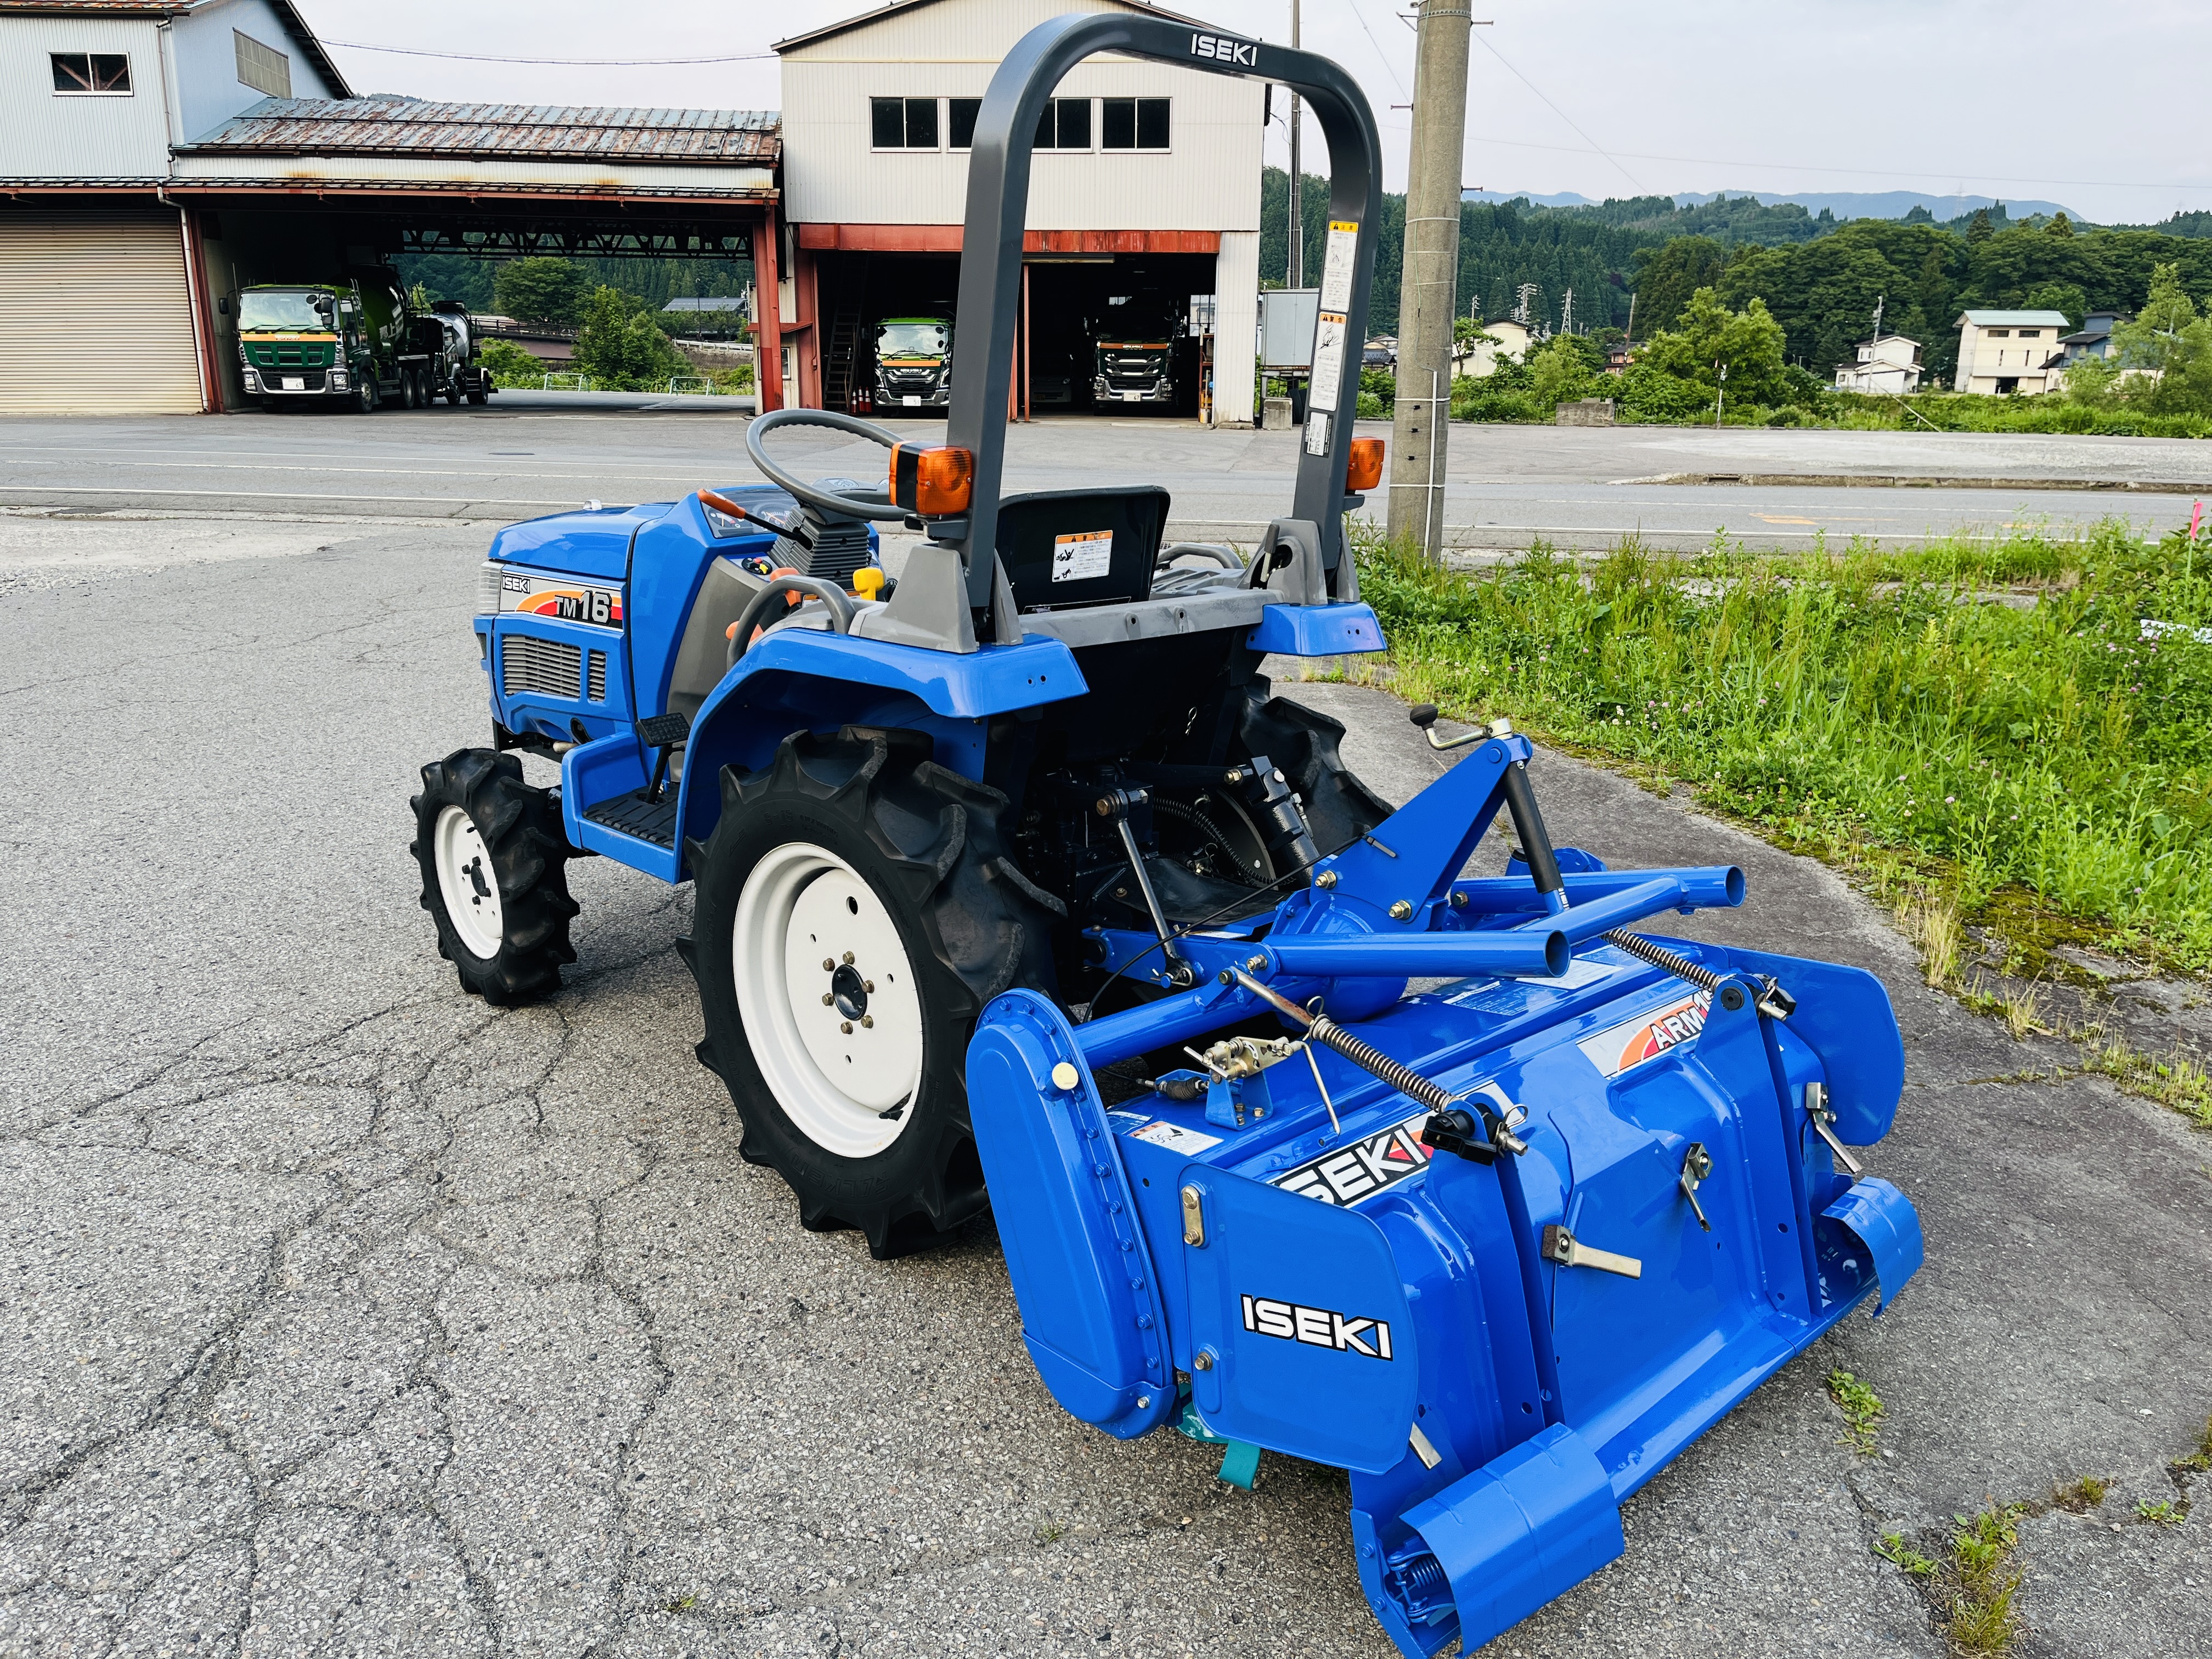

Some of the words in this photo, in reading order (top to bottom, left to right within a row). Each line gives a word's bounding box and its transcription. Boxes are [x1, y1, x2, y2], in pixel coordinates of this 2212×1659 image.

[1191, 33, 1257, 66] ISEKI
[502, 576, 530, 594] ISEKI
[1278, 1128, 1426, 1204] SEKI
[1240, 1294, 1393, 1361] ISEKI
